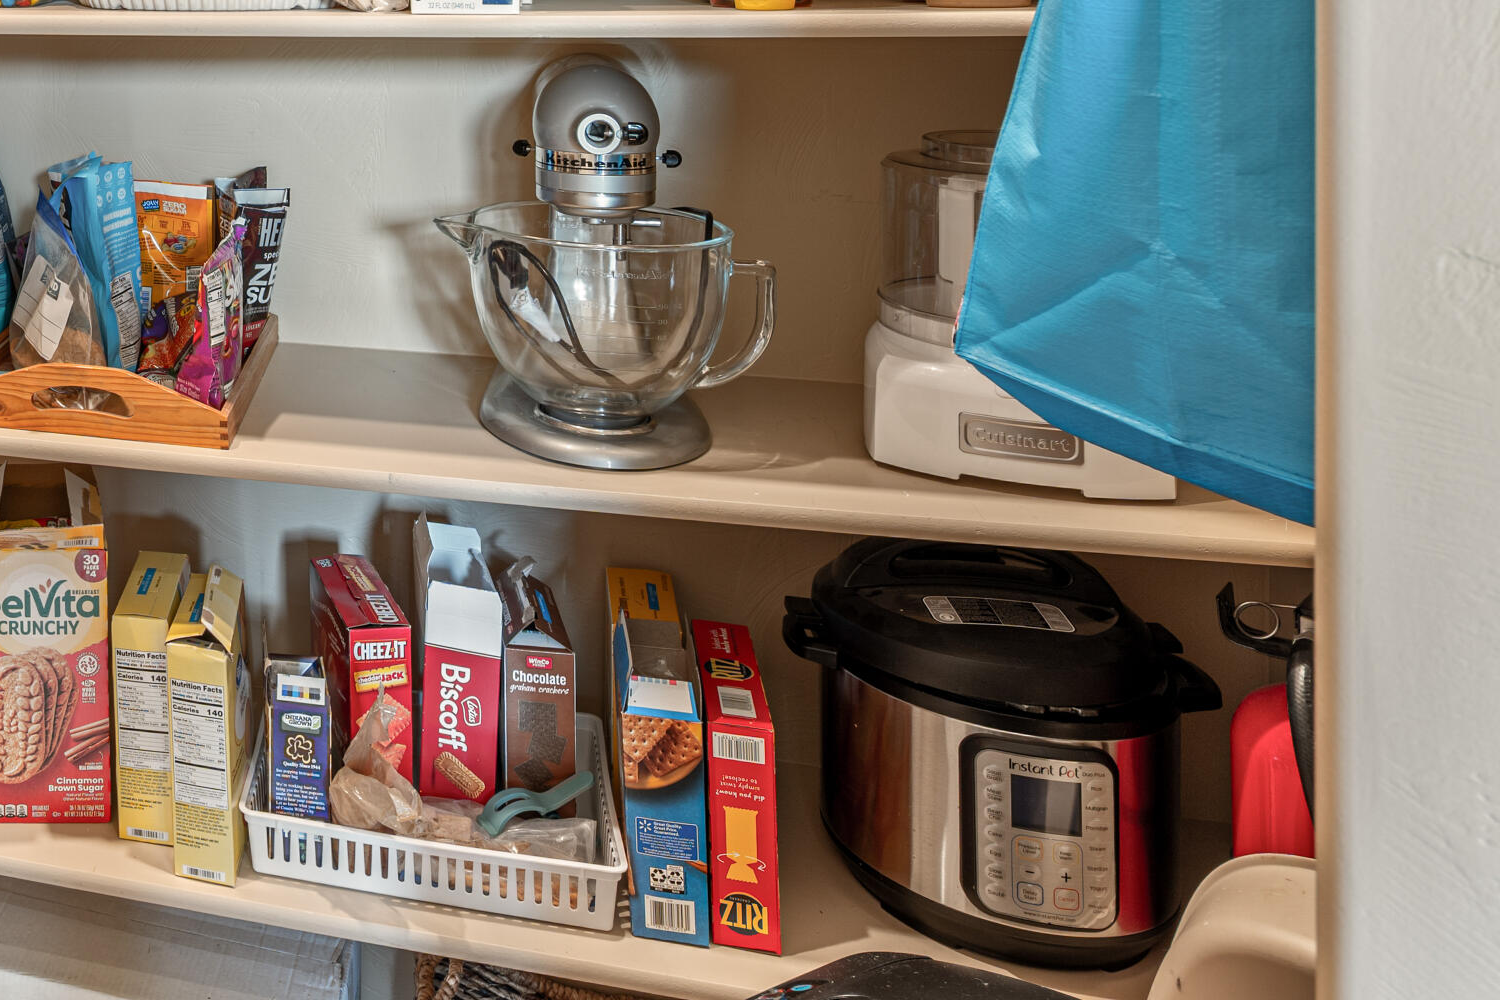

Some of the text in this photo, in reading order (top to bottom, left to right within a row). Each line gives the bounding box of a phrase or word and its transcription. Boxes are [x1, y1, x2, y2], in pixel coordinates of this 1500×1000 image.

[546, 153, 647, 169] KitchenAid
[162, 200, 187, 209] ZERO
[972, 426, 1070, 453] Cuisinart
[82, 554, 100, 565] 30
[116, 650, 166, 660] Nutrition Facts
[354, 640, 406, 660] CHEEZ-IT
[116, 672, 167, 682] Calories 140
[710, 658, 745, 682] RITZ
[512, 670, 567, 686] Chocolate
[172, 680, 222, 694] Nutrition Facts
[510, 683, 570, 694] graham crackers
[172, 704, 224, 718] Calories 140
[438, 662, 471, 752] Biscoff
[286, 714, 312, 722] INDIANA
[1008, 758, 1080, 778] Instant Pot
[56, 776, 104, 784] Cinnamon
[48, 784, 104, 793] Brown Sugar
[720, 898, 769, 935] RITZ
